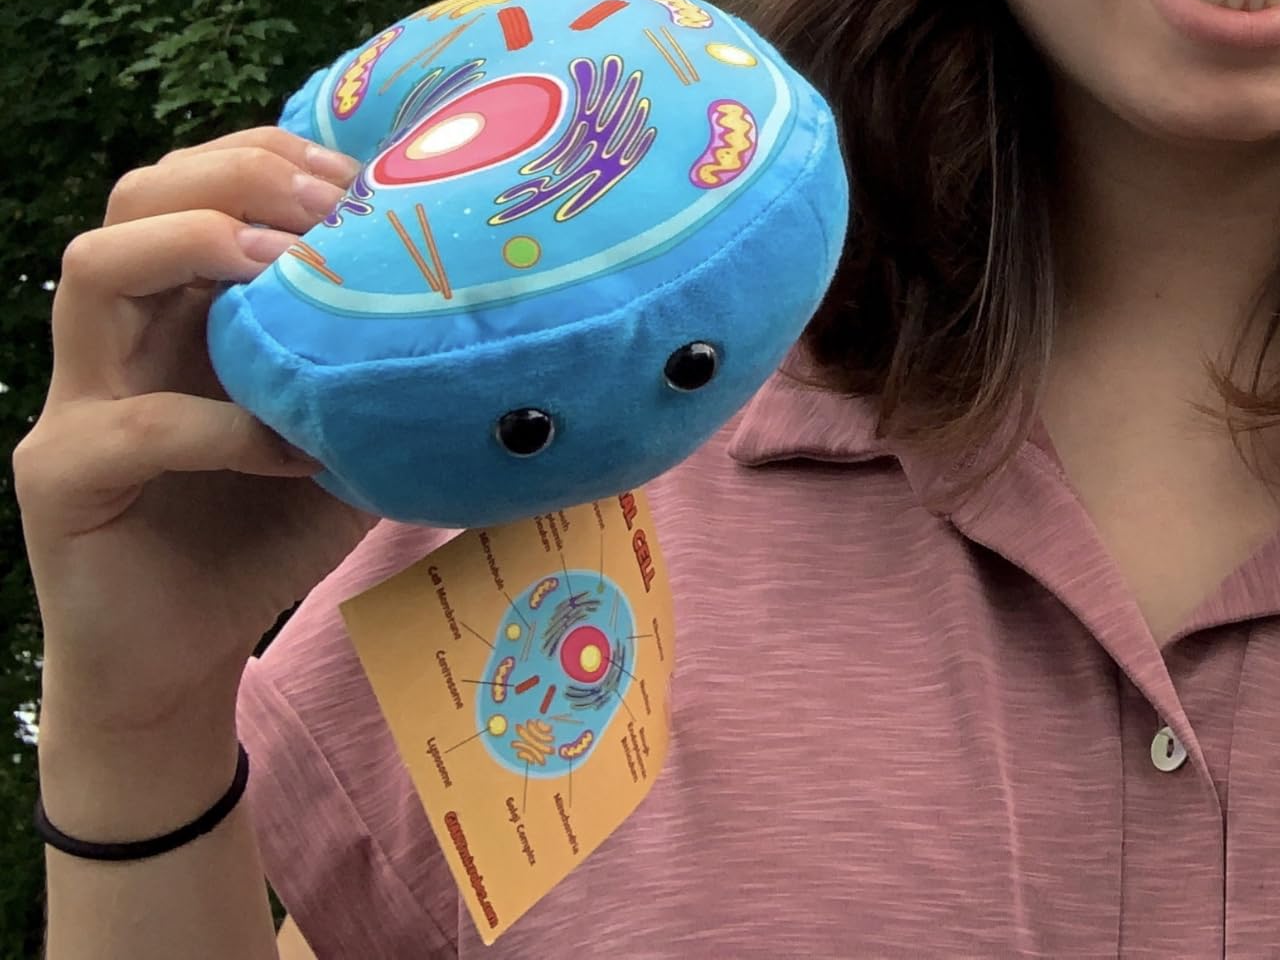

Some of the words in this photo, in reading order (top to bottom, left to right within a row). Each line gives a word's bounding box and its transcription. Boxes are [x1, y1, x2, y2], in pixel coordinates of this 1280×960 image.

[632, 529, 656, 593] CELL
[427, 566, 442, 586] Cell
[436, 587, 462, 640] Membrane
[435, 650, 464, 710] Centrosome
[426, 737, 453, 788] Lysosome
[516, 823, 536, 867] Complex
[553, 792, 579, 856] Mitochondria
